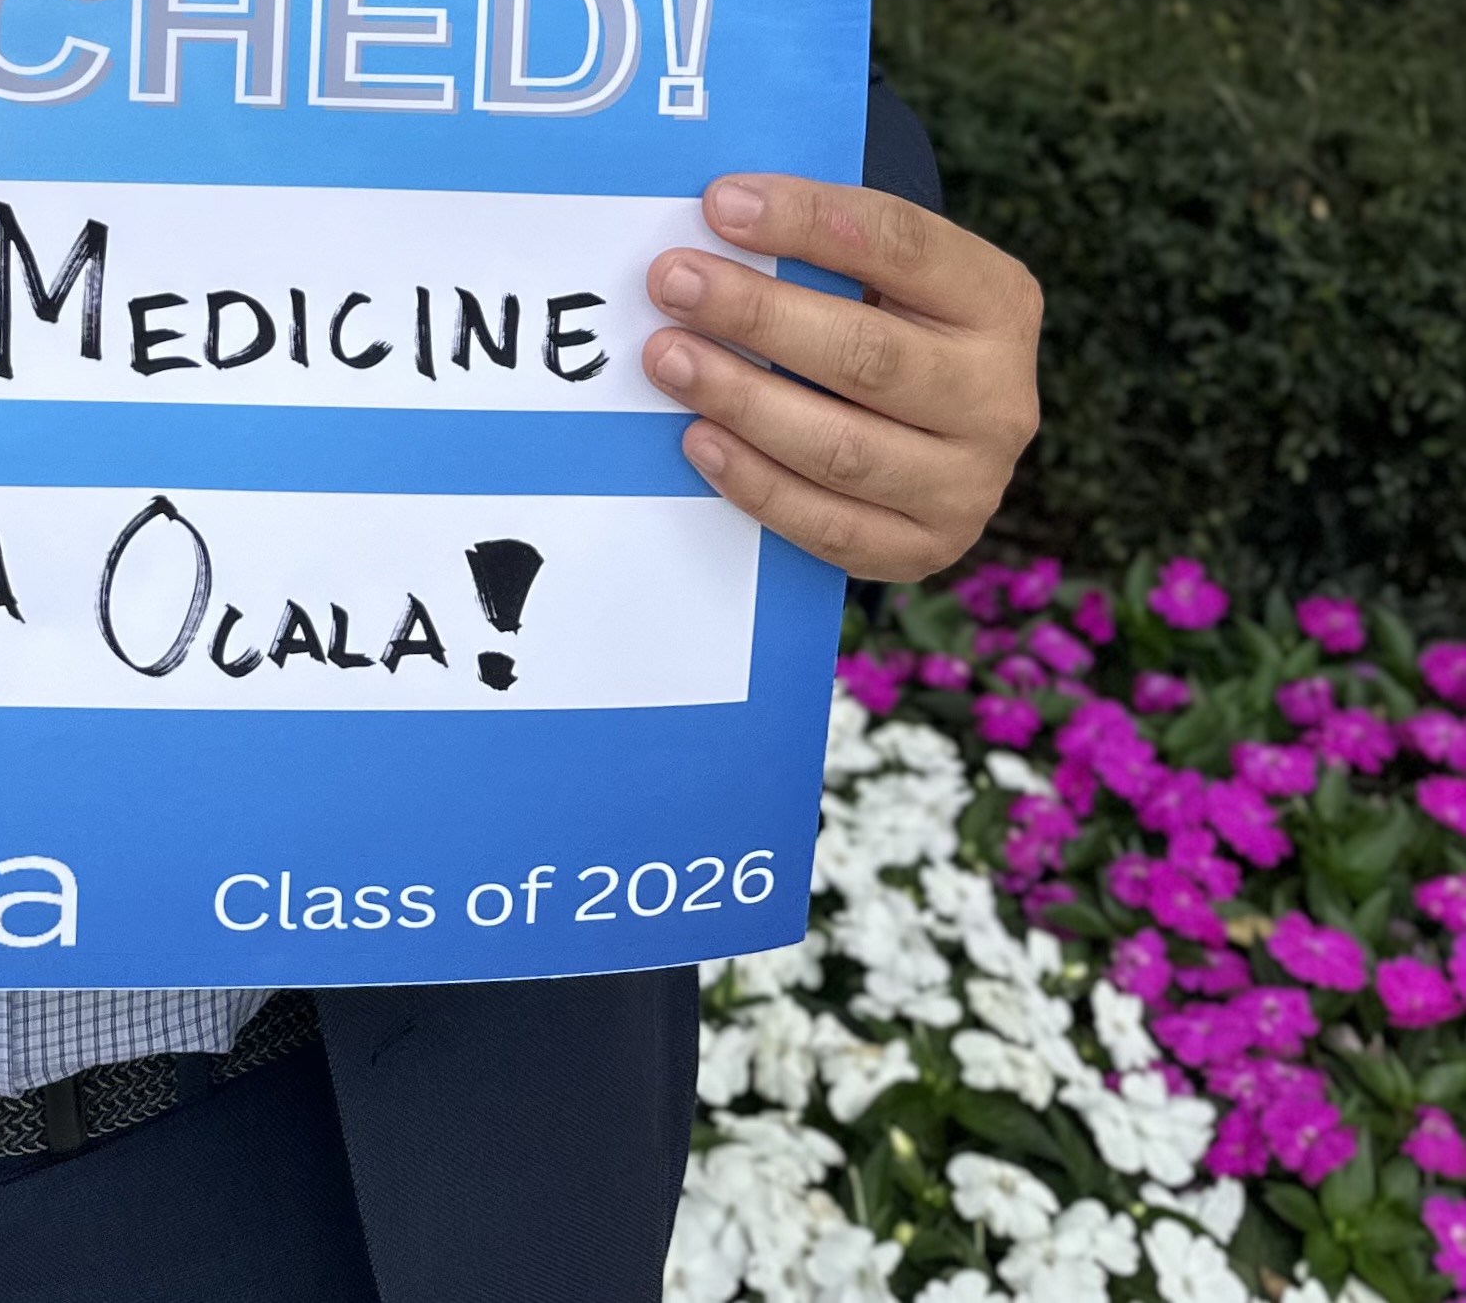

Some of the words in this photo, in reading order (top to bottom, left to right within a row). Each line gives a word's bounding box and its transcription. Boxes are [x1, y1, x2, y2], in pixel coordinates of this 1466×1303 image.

[95, 494, 544, 692] OCALA!
[214, 871, 437, 933] Class
[465, 864, 557, 928] of
[574, 849, 776, 924] 2026
